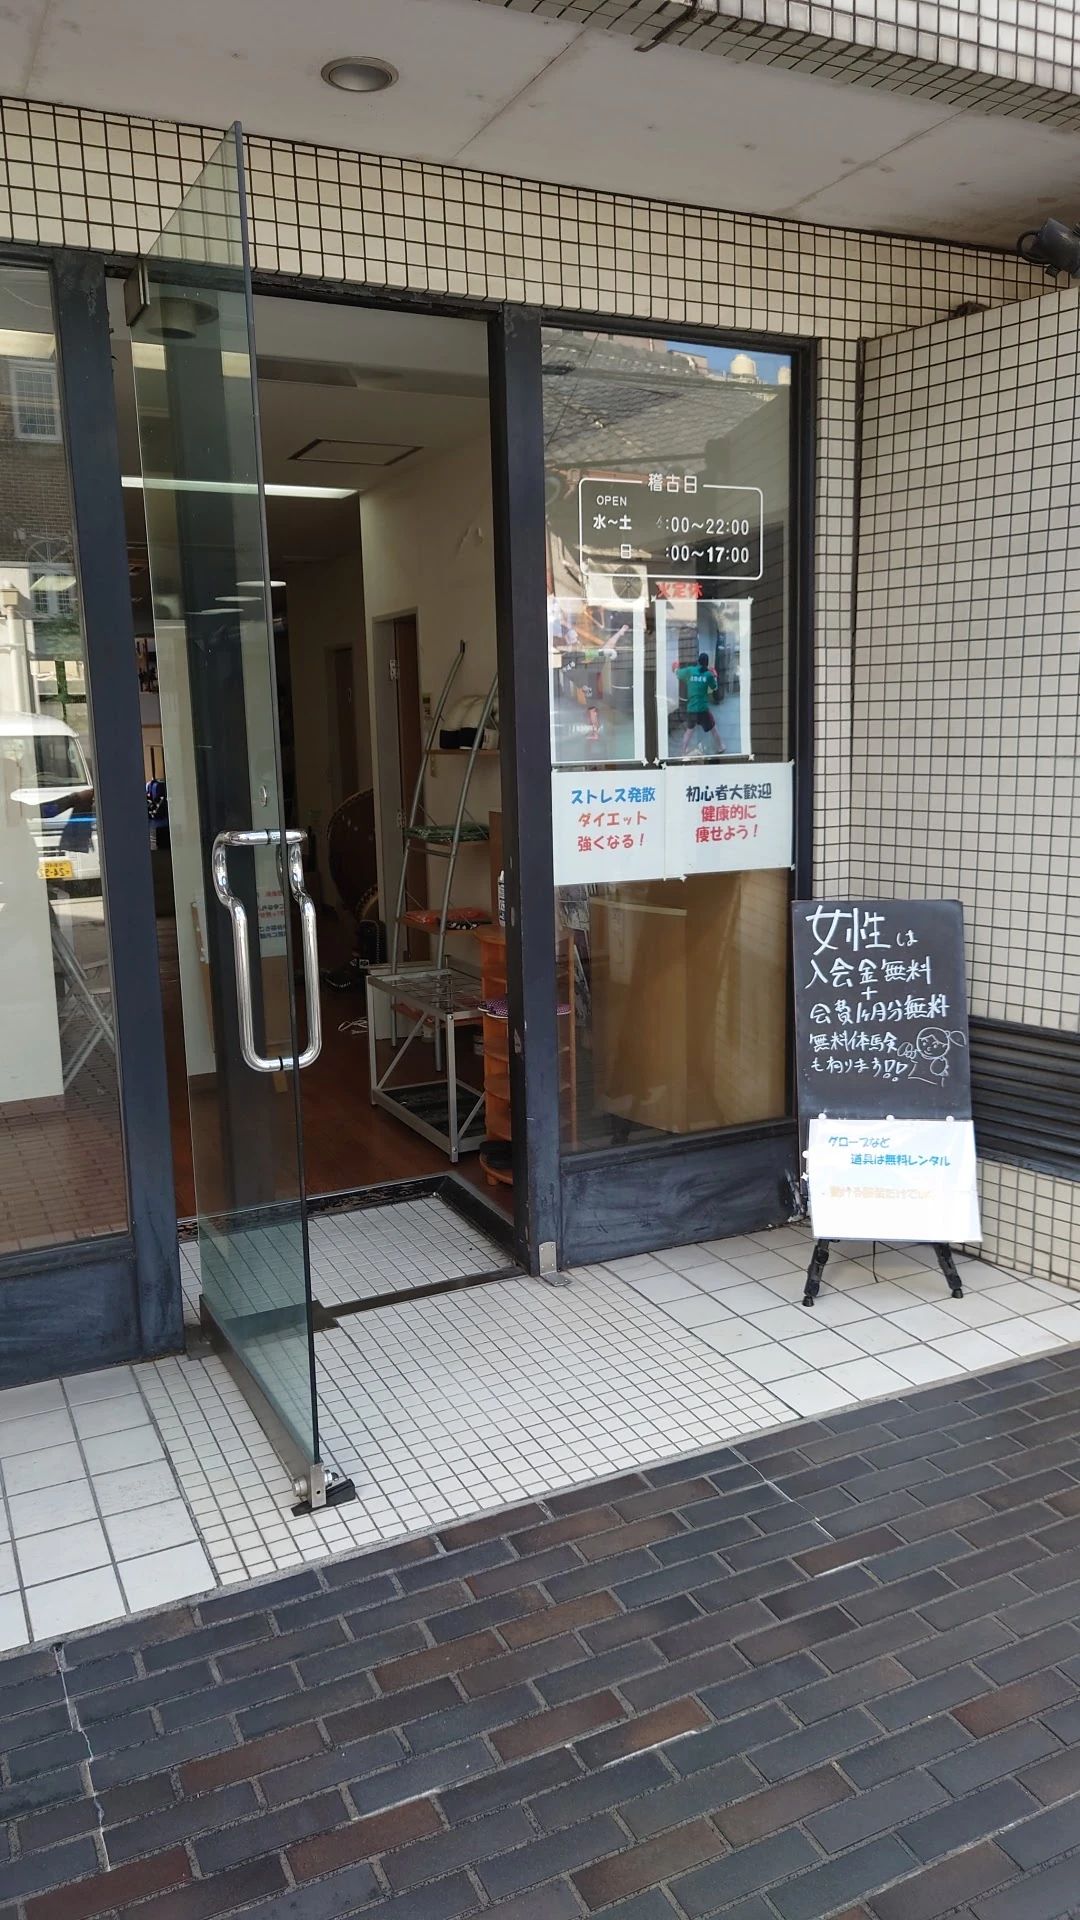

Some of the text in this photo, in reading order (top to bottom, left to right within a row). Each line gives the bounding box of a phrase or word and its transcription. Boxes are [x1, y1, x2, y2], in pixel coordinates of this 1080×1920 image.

[648, 473, 698, 494] 稽古日
[596, 495, 628, 507] OPEN
[620, 544, 632, 560] 日
[571, 786, 656, 805] ストレス発散
[686, 782, 773, 803] 初心者大歓迎
[578, 811, 648, 828] ダイエット
[701, 804, 758, 823] 健康的に
[805, 904, 919, 956] 女性は
[804, 955, 933, 990] 入会金無料
[809, 1030, 899, 1053] 無料体験
[851, 1153, 951, 1167] 道具は無料レンタル
